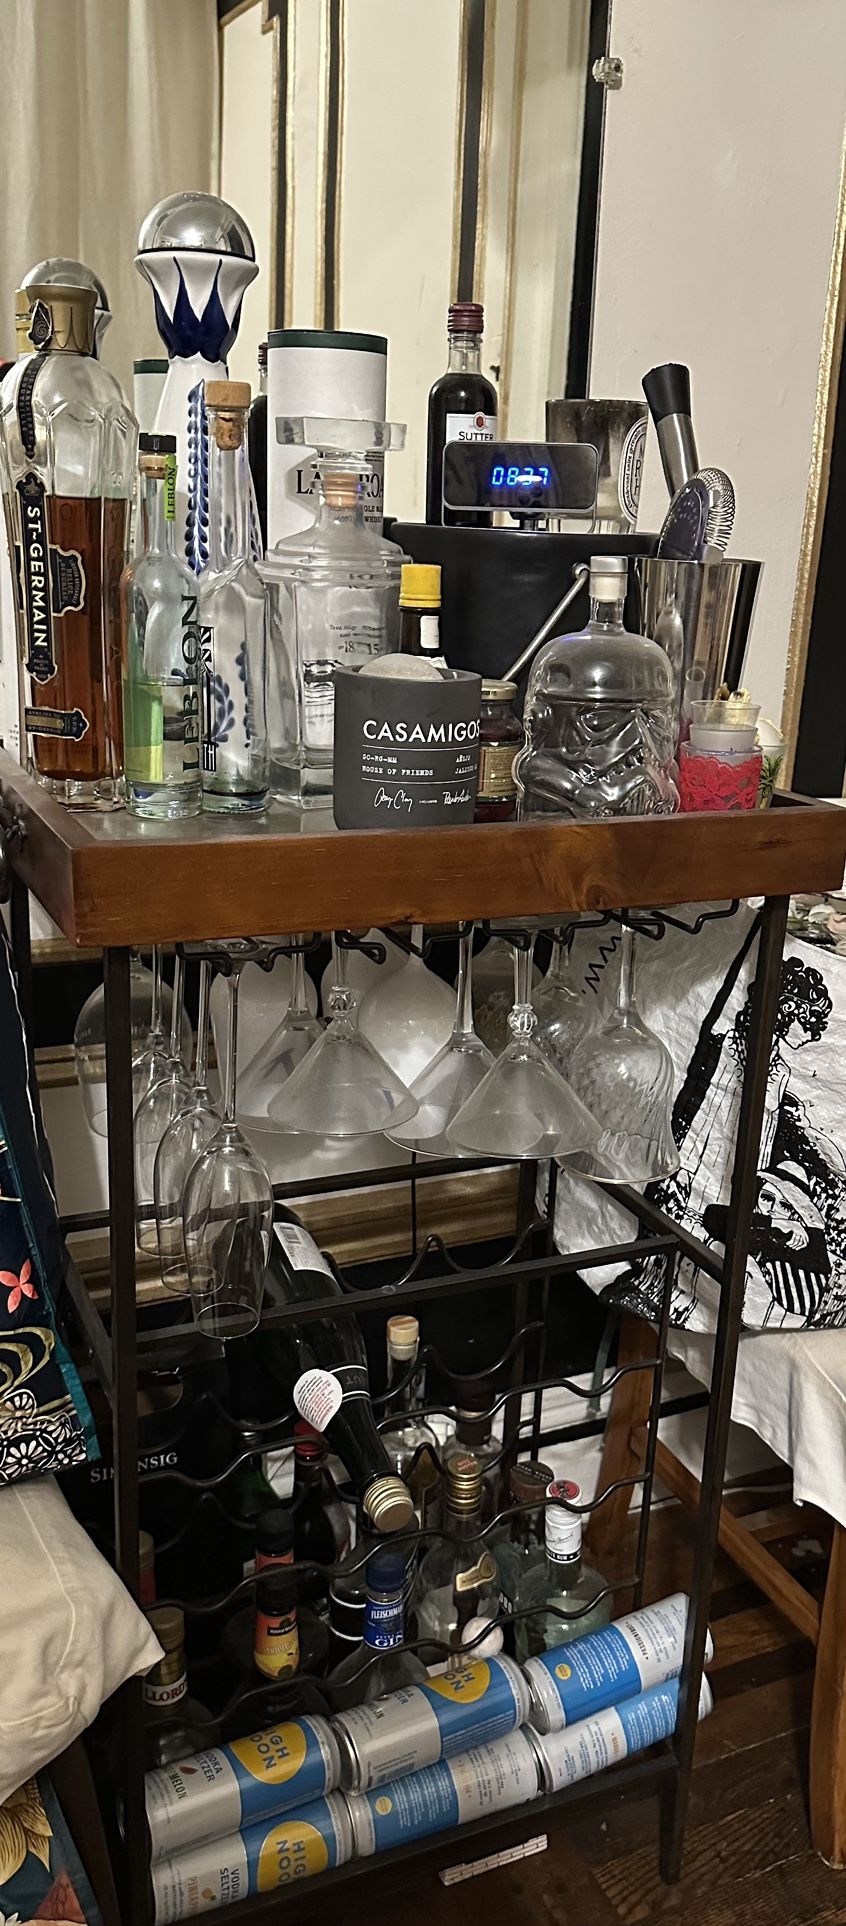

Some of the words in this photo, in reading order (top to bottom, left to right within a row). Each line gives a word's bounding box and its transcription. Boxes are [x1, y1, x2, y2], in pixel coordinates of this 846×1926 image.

[458, 431, 494, 441] SUTTER
[167, 465, 177, 515] LEBLON
[181, 594, 199, 773] LEBLON
[362, 719, 480, 743] CASAMIGOS
[361, 765, 384, 774] HOUSE
[250, 1733, 277, 1770] OON
[276, 1839, 291, 1882] NOO
[293, 1839, 307, 1879] HIG
